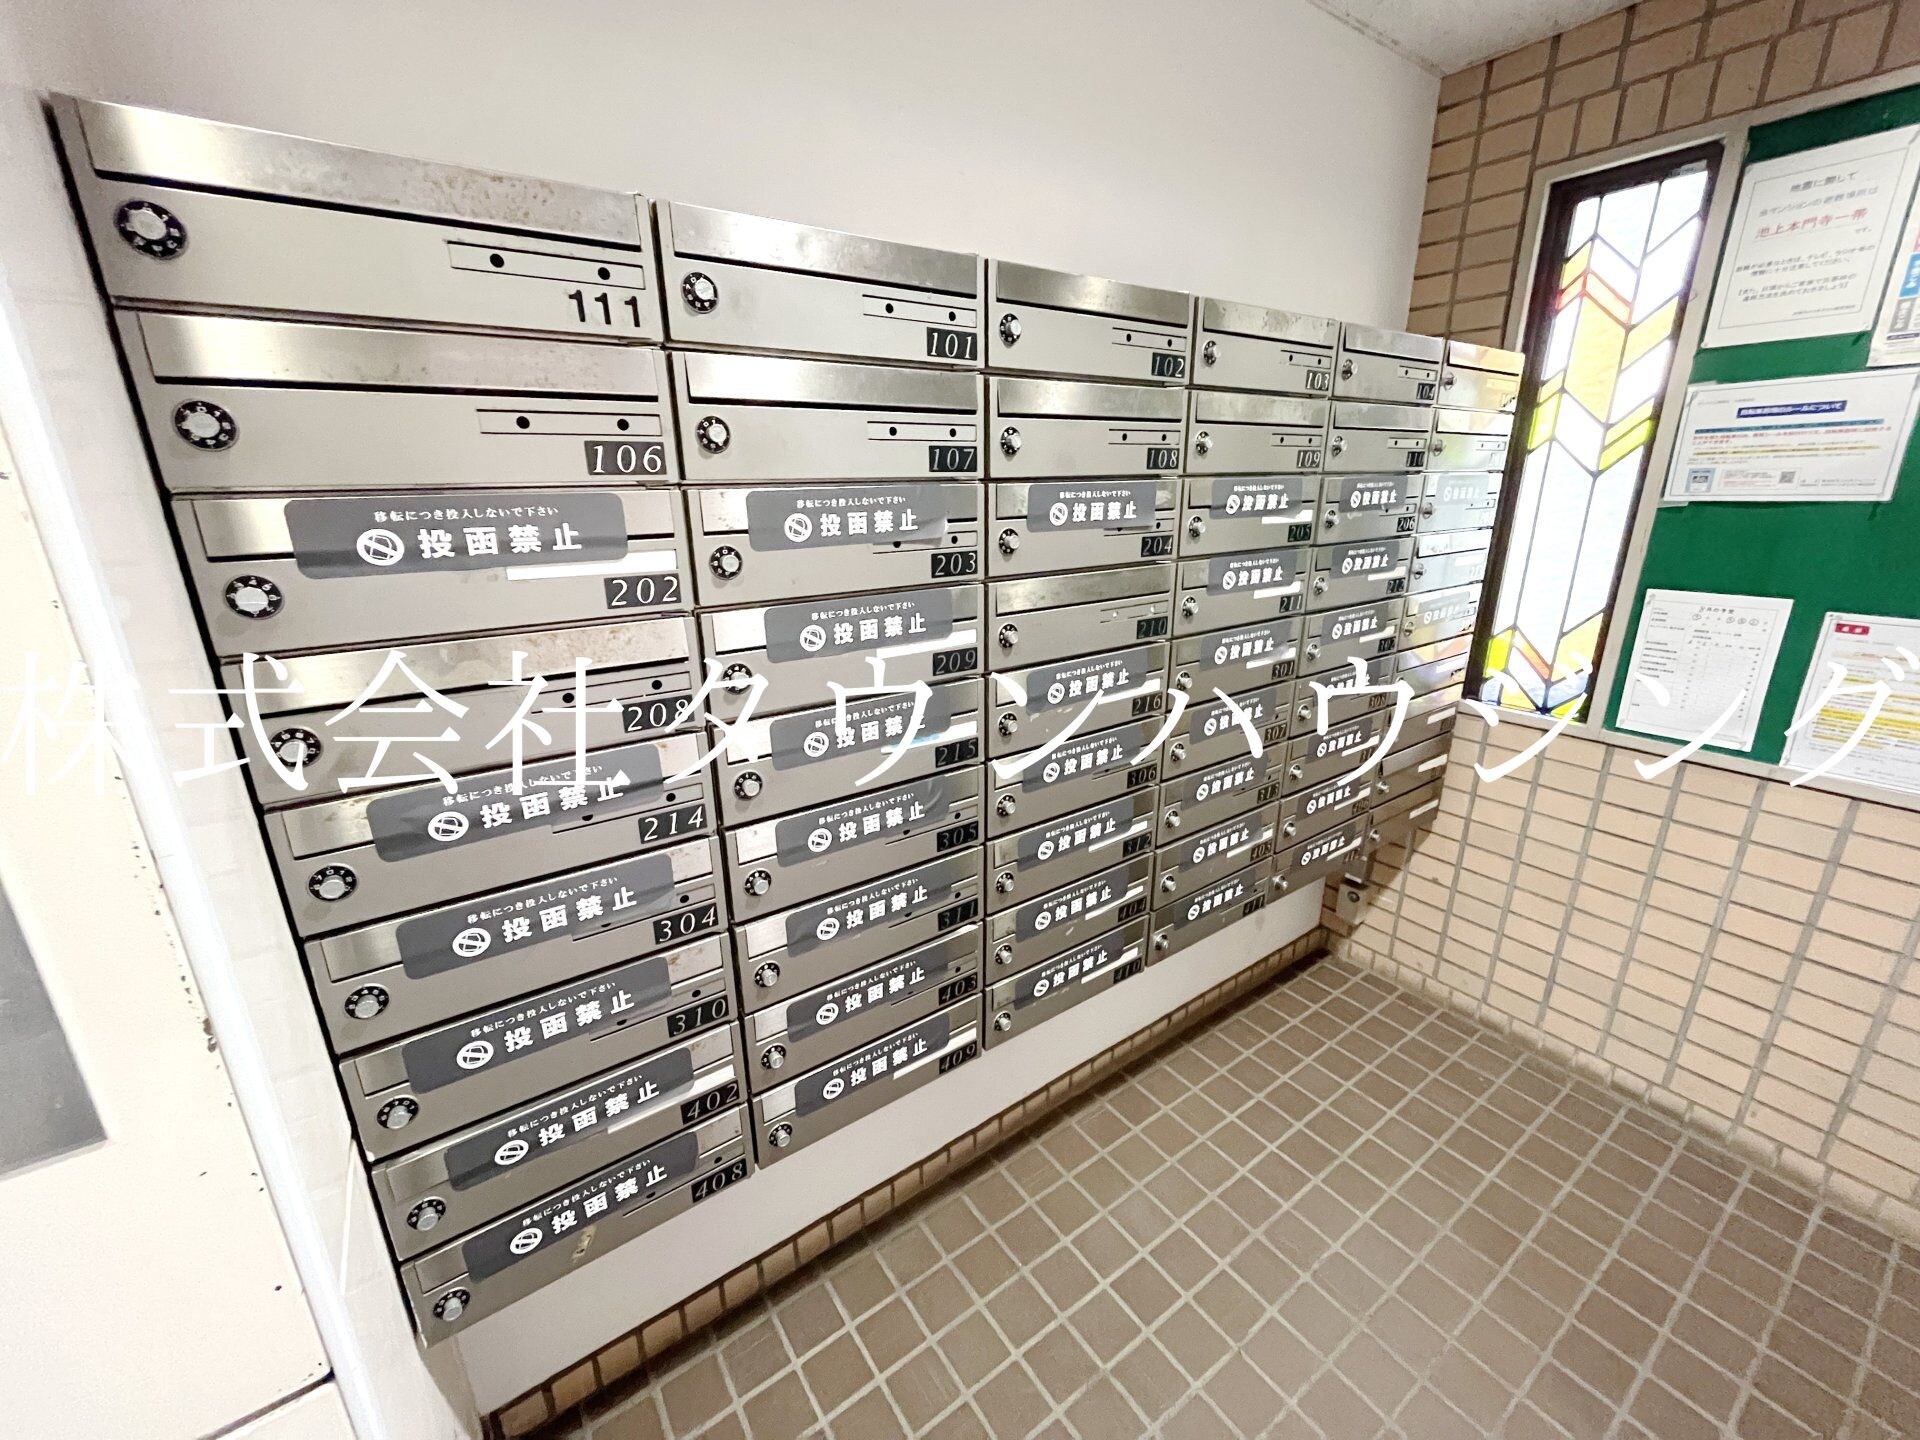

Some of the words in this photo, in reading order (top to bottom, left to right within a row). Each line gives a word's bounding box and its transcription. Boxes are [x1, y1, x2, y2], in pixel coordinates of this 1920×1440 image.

[568, 289, 642, 329] 111
[929, 332, 973, 360] 101
[1153, 355, 1185, 378] 102
[1306, 371, 1330, 391] 103
[590, 443, 665, 475] 106
[932, 446, 976, 472] 107
[1148, 449, 1178, 469] 108
[1298, 450, 1321, 468] 109
[373, 505, 559, 524] 移転につき投入しないで下さい
[819, 508, 919, 538] 投函禁止
[417, 522, 583, 560] 投函禁止
[1142, 536, 1173, 557] 204
[934, 552, 978, 577] 203
[609, 576, 680, 608] 202
[1280, 595, 1303, 613] 211
[833, 612, 927, 646] 投函禁止
[1138, 617, 1168, 640] 210
[935, 648, 978, 675] 209
[626, 698, 693, 732] 208
[1134, 694, 1163, 716] 216
[937, 740, 978, 767] 215
[643, 808, 705, 842] 214
[838, 800, 926, 843] 投函禁止
[939, 822, 979, 851] 305
[466, 874, 619, 924] 移転につき投入しないで下さい
[501, 886, 638, 944] 投函禁止
[845, 885, 929, 930] 投函禁止
[658, 910, 718, 944] 304
[939, 901, 978, 930] 311
[844, 966, 926, 1014] 投函禁止
[503, 989, 636, 1054] 投函禁止
[672, 999, 729, 1037] 310
[849, 1038, 929, 1087] 投函禁止
[538, 1081, 660, 1148] 投函禁止
[686, 1083, 740, 1121] 402
[694, 1161, 746, 1201] 408
[551, 1164, 669, 1236] 投函禁止
